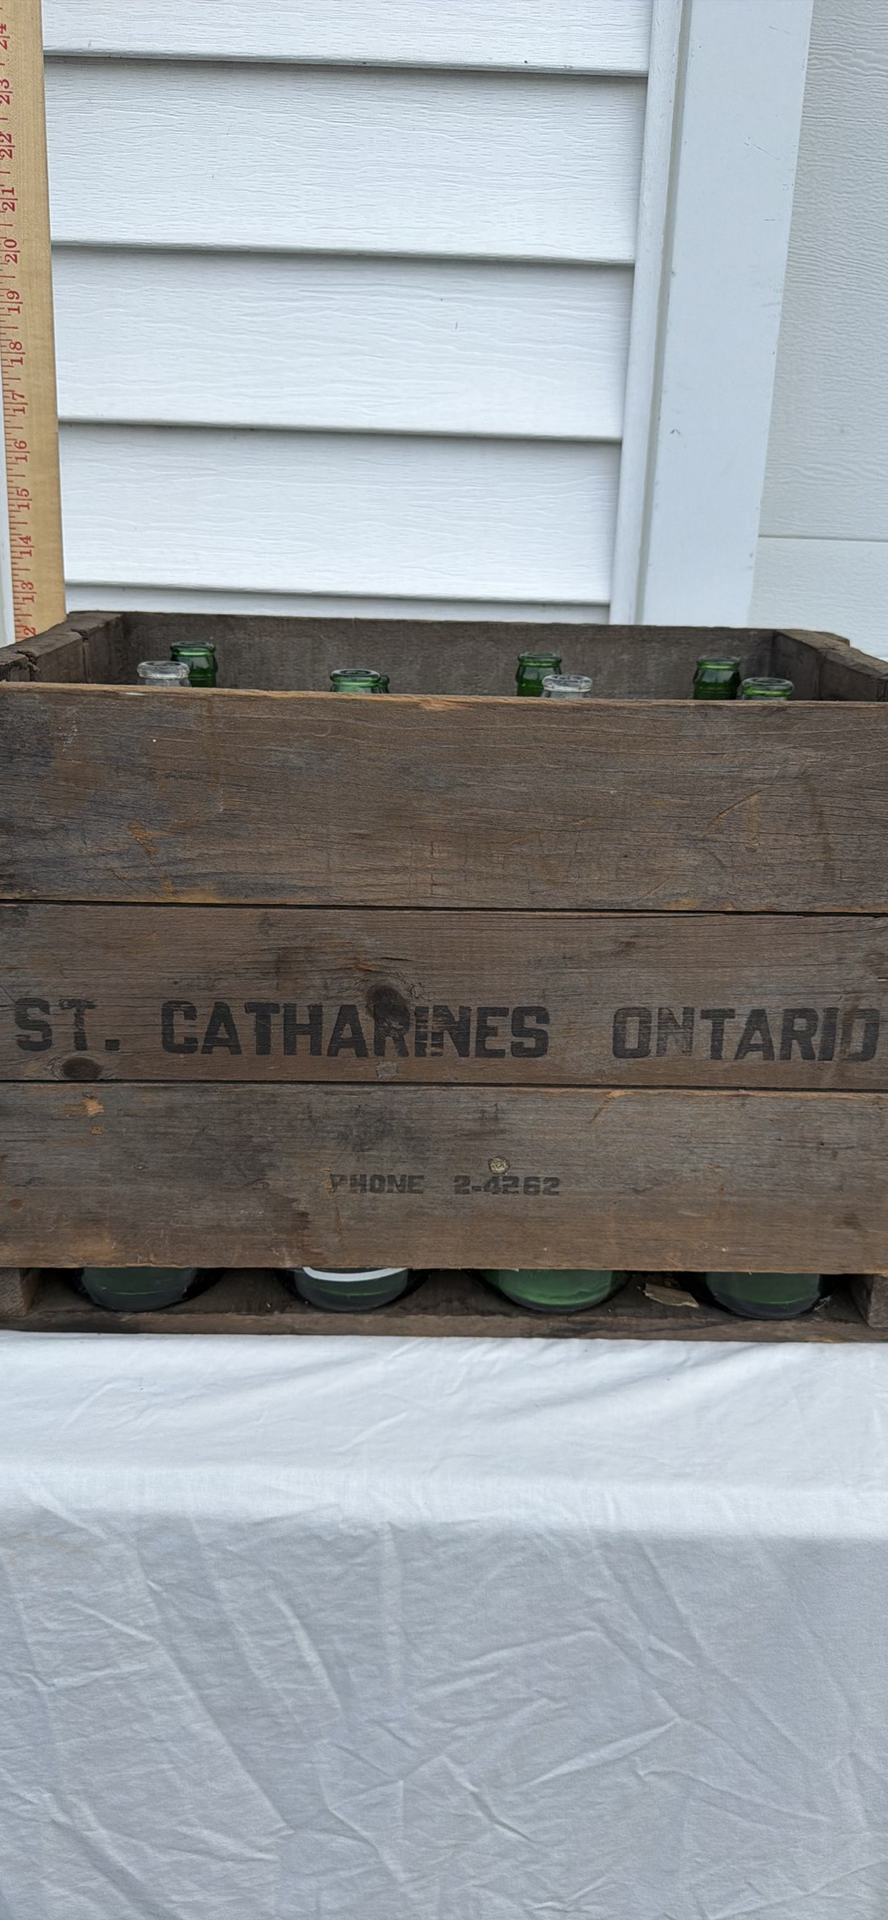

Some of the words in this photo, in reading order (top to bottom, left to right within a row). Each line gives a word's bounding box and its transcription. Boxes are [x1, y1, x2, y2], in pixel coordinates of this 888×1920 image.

[0, 133, 13, 159] 22
[2, 187, 15, 212] 21
[4, 239, 18, 264] 20
[6, 290, 20, 314] 19
[9, 341, 23, 365] 18
[11, 392, 25, 415] 17
[14, 440, 28, 462] 16
[17, 488, 30, 510] 15
[19, 535, 32, 557] 14
[21, 581, 35, 603] 13
[15, 997, 120, 1052] ST.
[161, 1000, 550, 1059] CATHARINES
[612, 1005, 881, 1062] ONTARIO
[329, 1173, 425, 1194] PHONE
[454, 1175, 561, 1196] 2-4262
